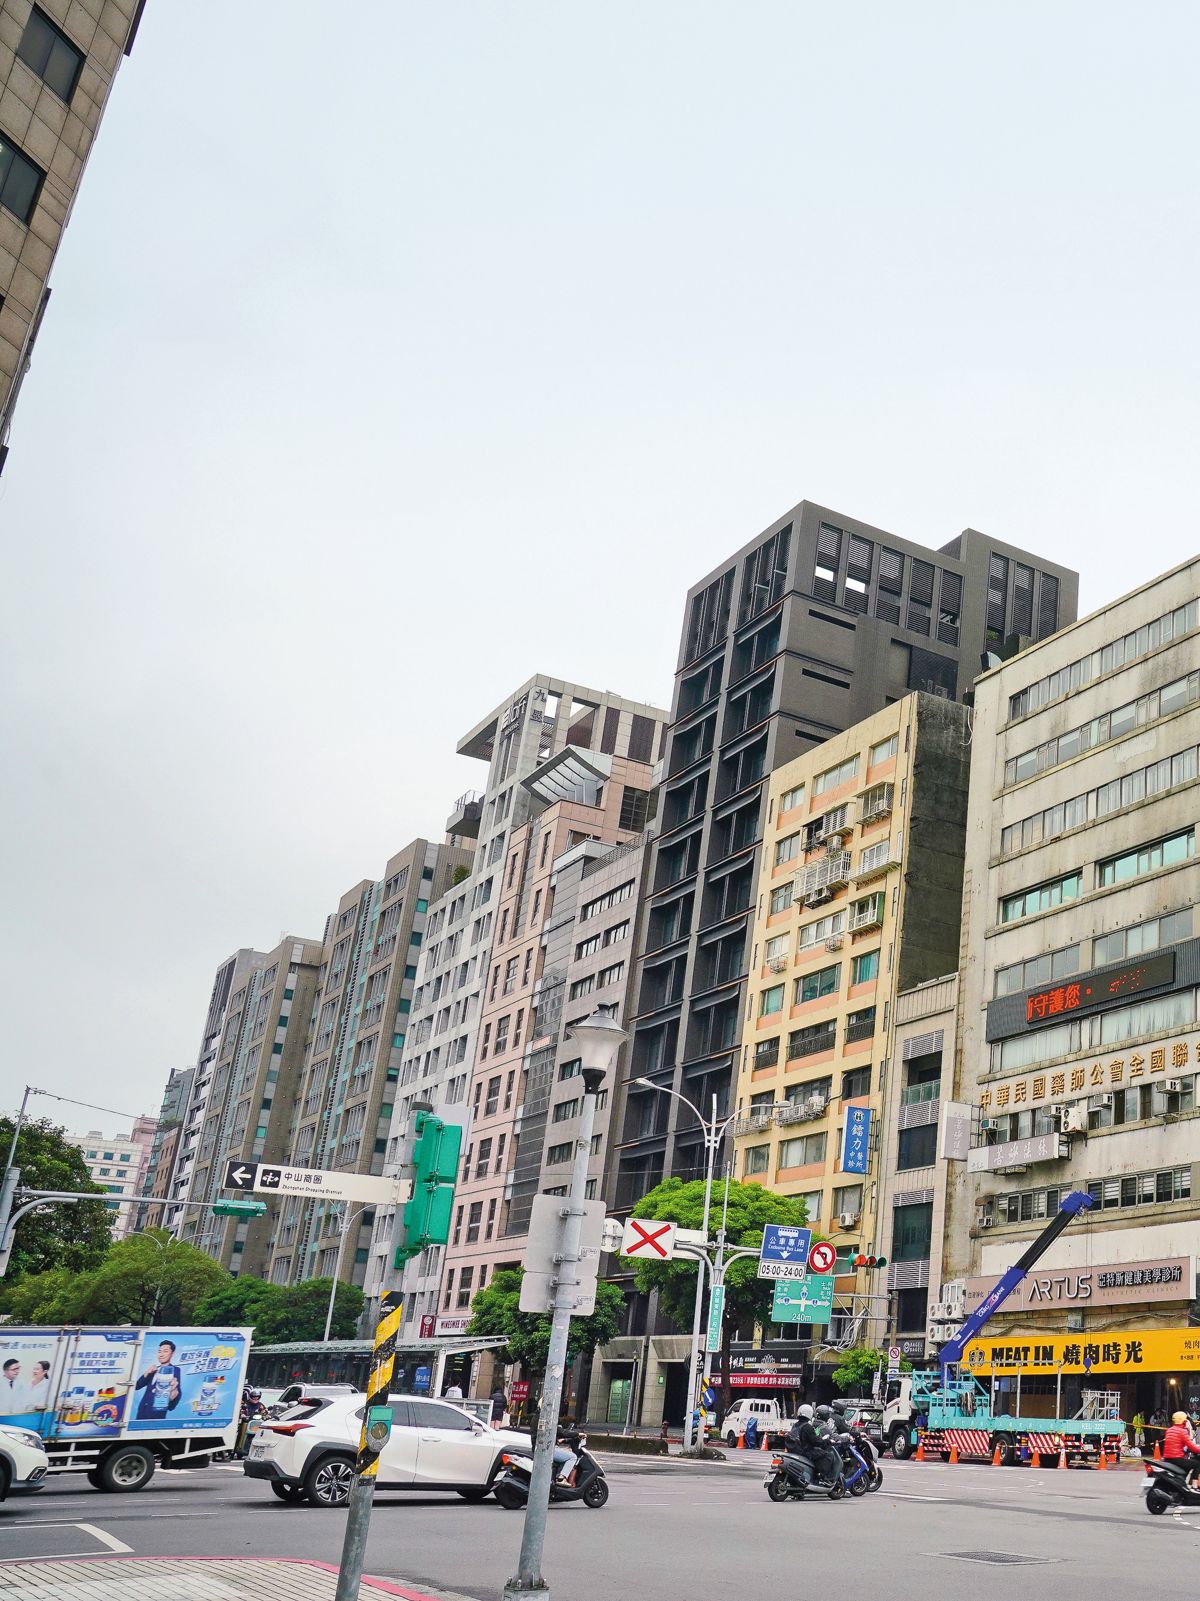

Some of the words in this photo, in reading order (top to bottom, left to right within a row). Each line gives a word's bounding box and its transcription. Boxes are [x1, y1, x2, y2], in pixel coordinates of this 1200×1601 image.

[284, 1173, 323, 1185] 中山商圈
[769, 1236, 805, 1247] 公車專用
[1098, 1265, 1182, 1288] 亞特斯健康美學診所
[1028, 1274, 1092, 1302] ARTUS
[792, 1313, 812, 1321] 240m
[991, 1347, 1030, 1367] MEAT
[1033, 1345, 1054, 1367] IN
[1062, 1341, 1143, 1366] 燒肉時光
